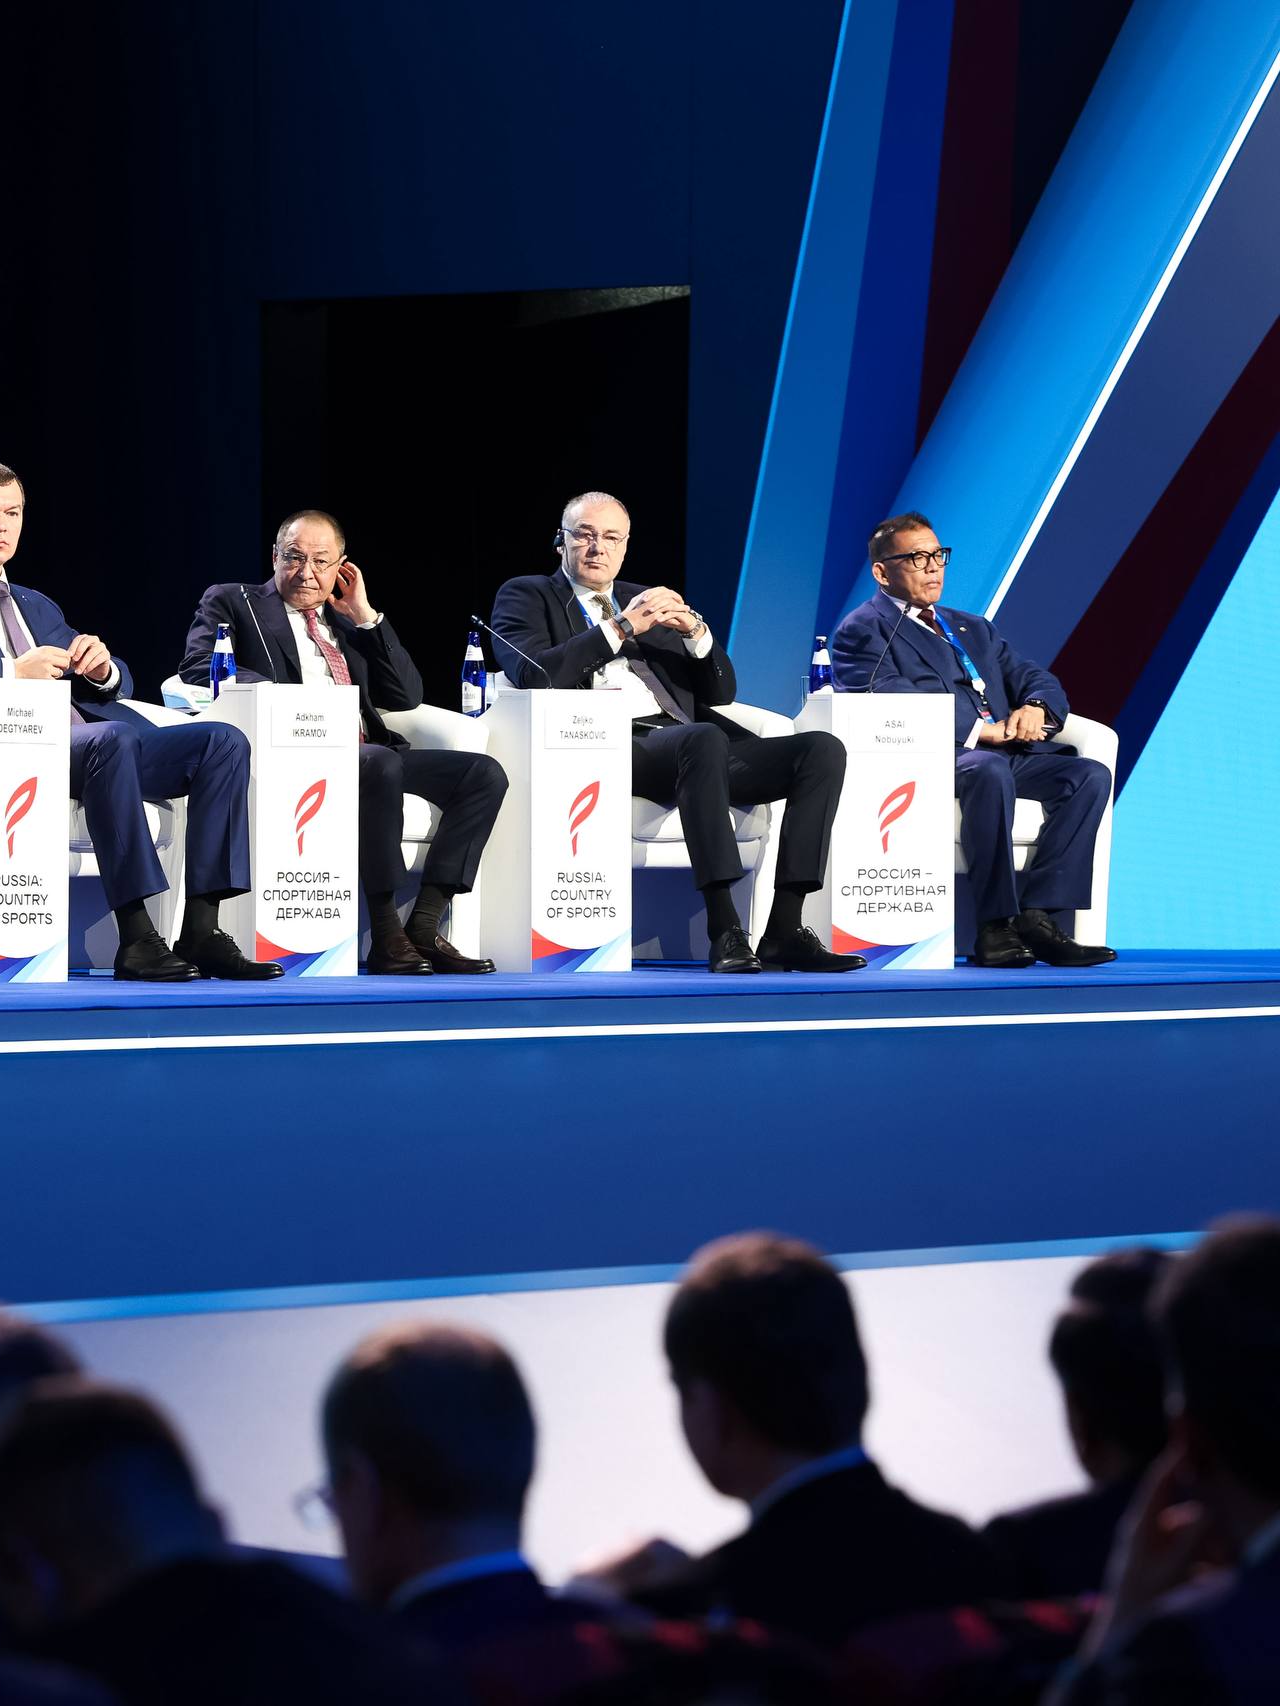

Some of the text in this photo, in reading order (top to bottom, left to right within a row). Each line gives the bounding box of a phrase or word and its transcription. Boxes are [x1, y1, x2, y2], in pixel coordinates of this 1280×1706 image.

[7, 707, 34, 718] Michael
[295, 712, 325, 722] Adkham
[884, 719, 905, 729] ASAI
[292, 728, 327, 738] IKRAMOV
[276, 871, 330, 884] РОССИЯ
[557, 871, 606, 884] RUSSIA:
[857, 868, 921, 880] РОССИЯ
[262, 889, 352, 901] СПОРТИВНАЯ
[550, 889, 612, 901] COUNTRY
[840, 885, 947, 897] СПОРТИВНАЯ
[275, 907, 341, 921] ДЕРЖАВА
[546, 906, 617, 919] OF SPORTS
[856, 901, 934, 915] ДЕРЖАВА
[1, 912, 53, 925] SPORTS
